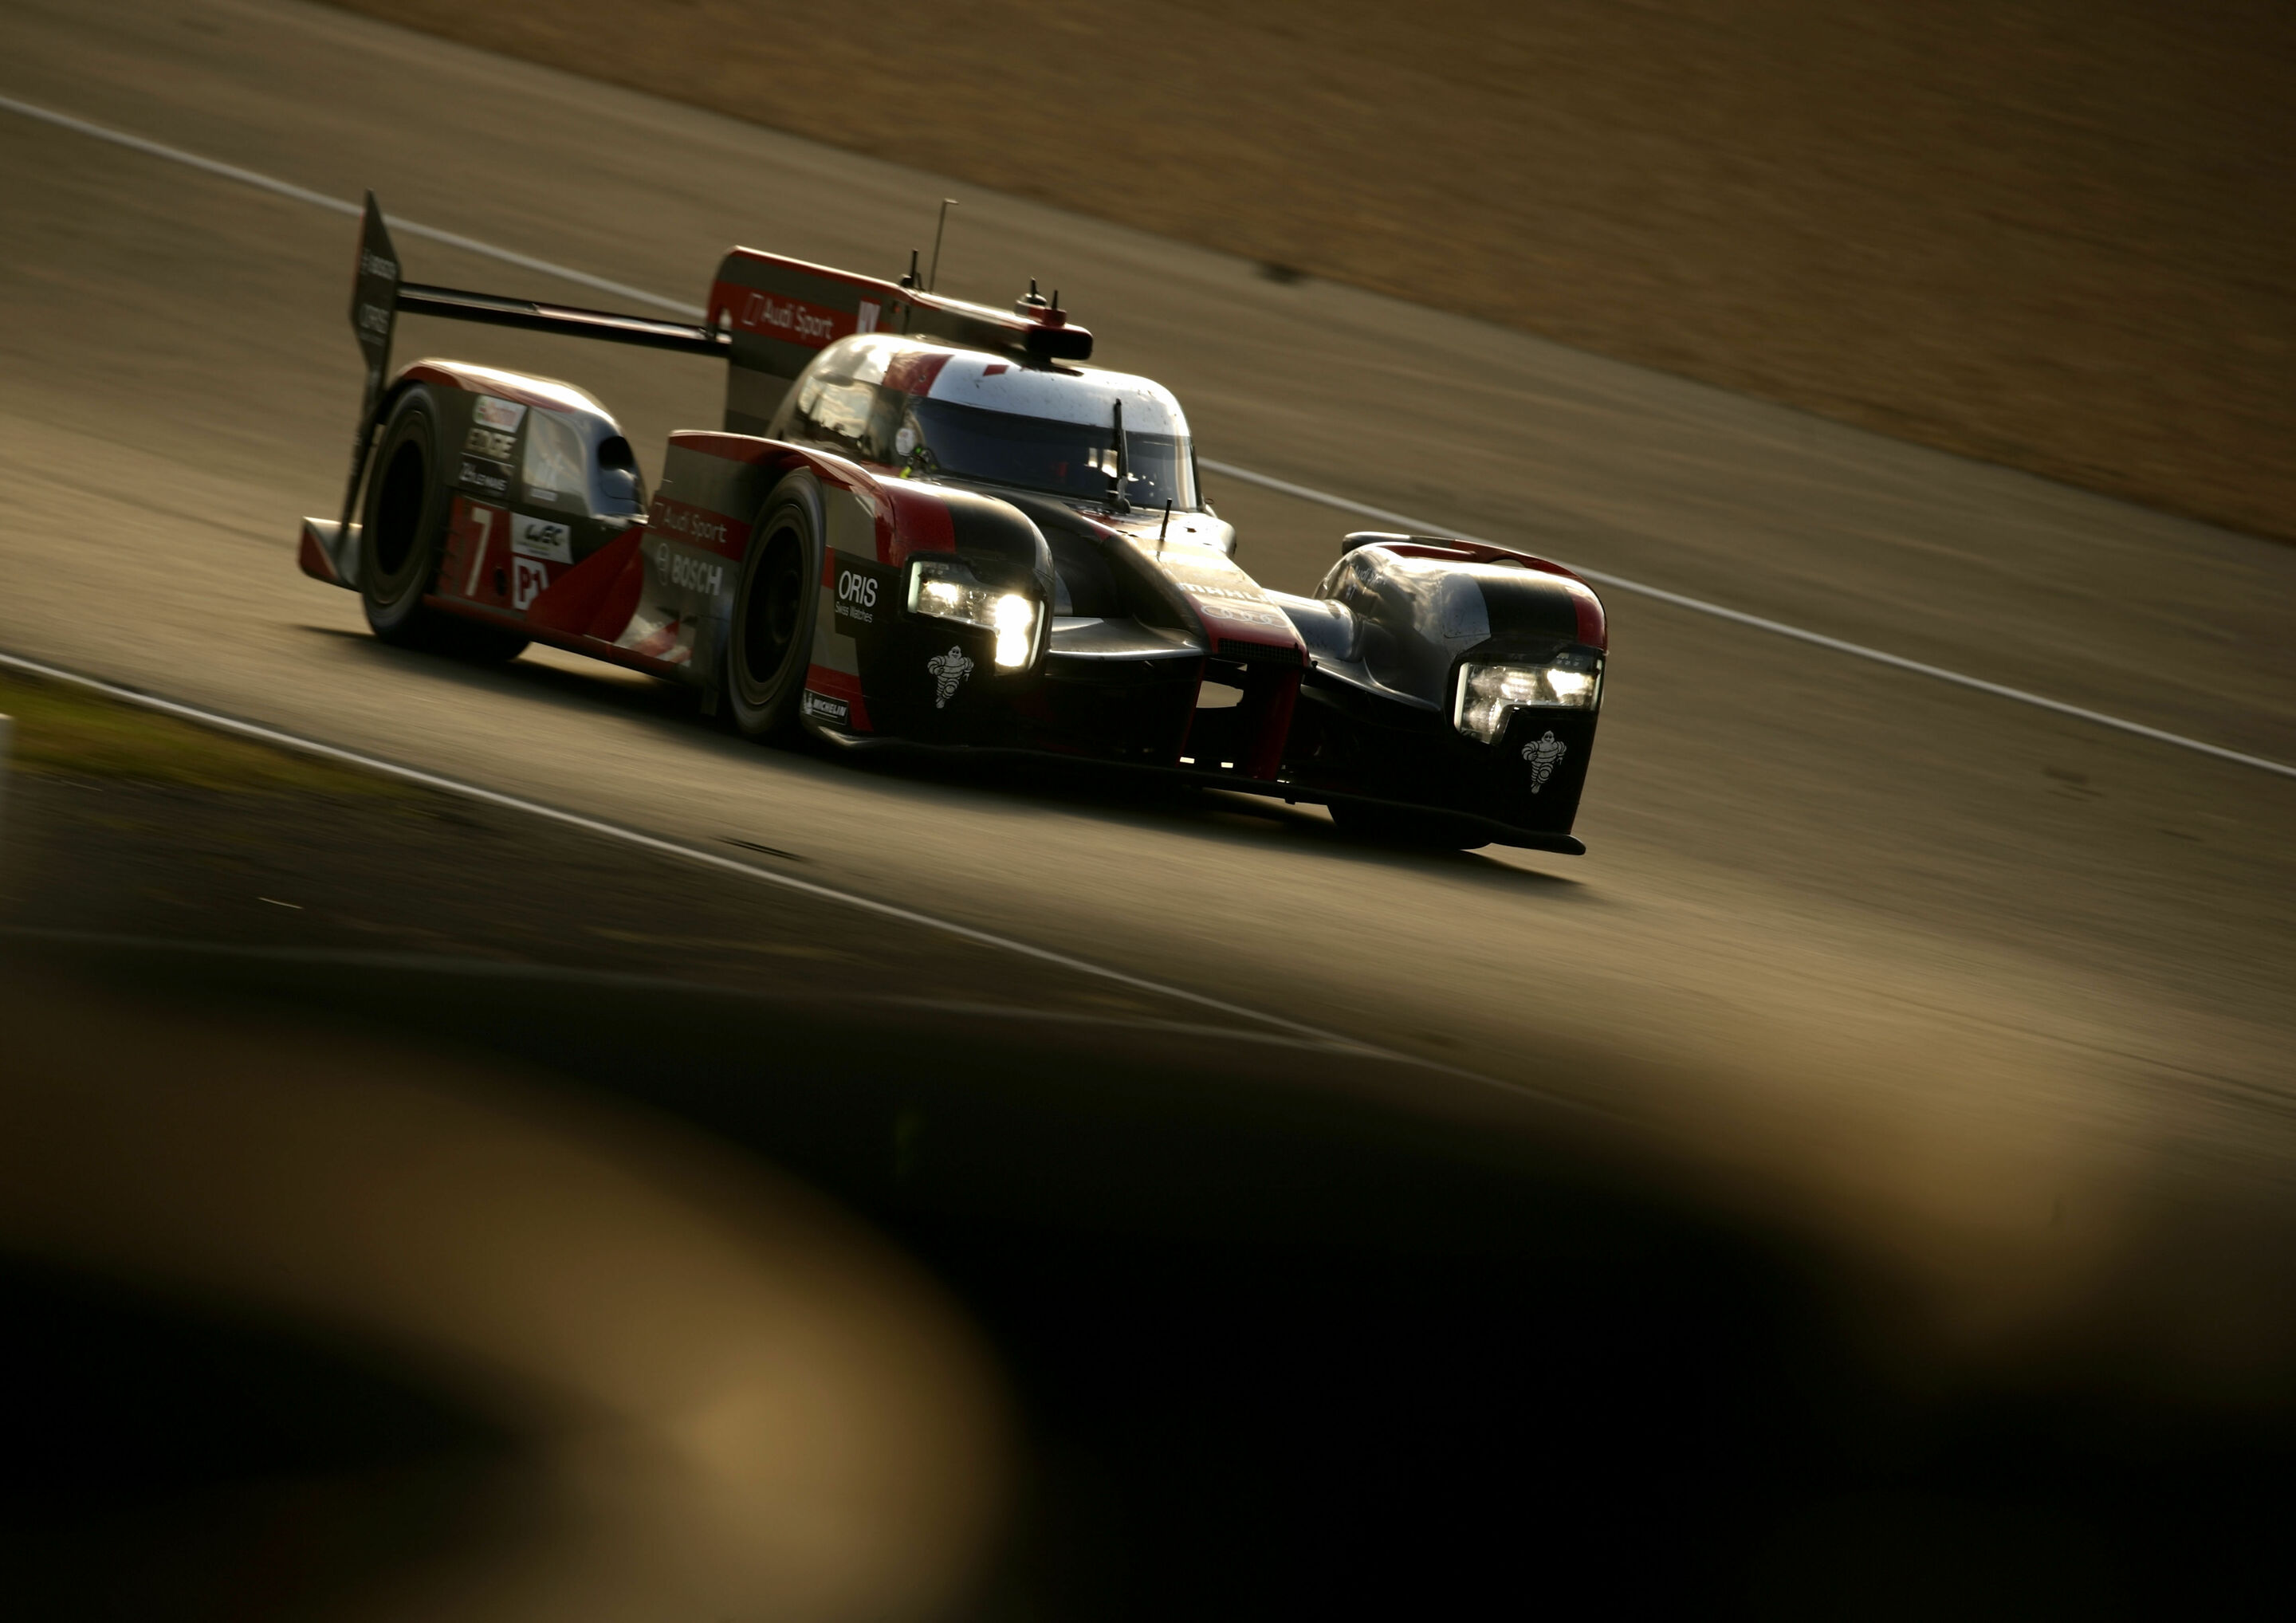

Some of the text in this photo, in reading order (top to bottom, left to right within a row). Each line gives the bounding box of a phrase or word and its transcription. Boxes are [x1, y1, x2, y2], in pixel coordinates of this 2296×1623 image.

[761, 297, 835, 340] Audi Sport
[663, 505, 728, 544] Audi Sport
[465, 507, 493, 597] 7
[519, 564, 543, 603] P1
[671, 554, 723, 596] BOSCH
[839, 570, 878, 608] ORIS
[835, 600, 874, 623] Swiss Watches
[813, 698, 847, 717] MICHELIN
